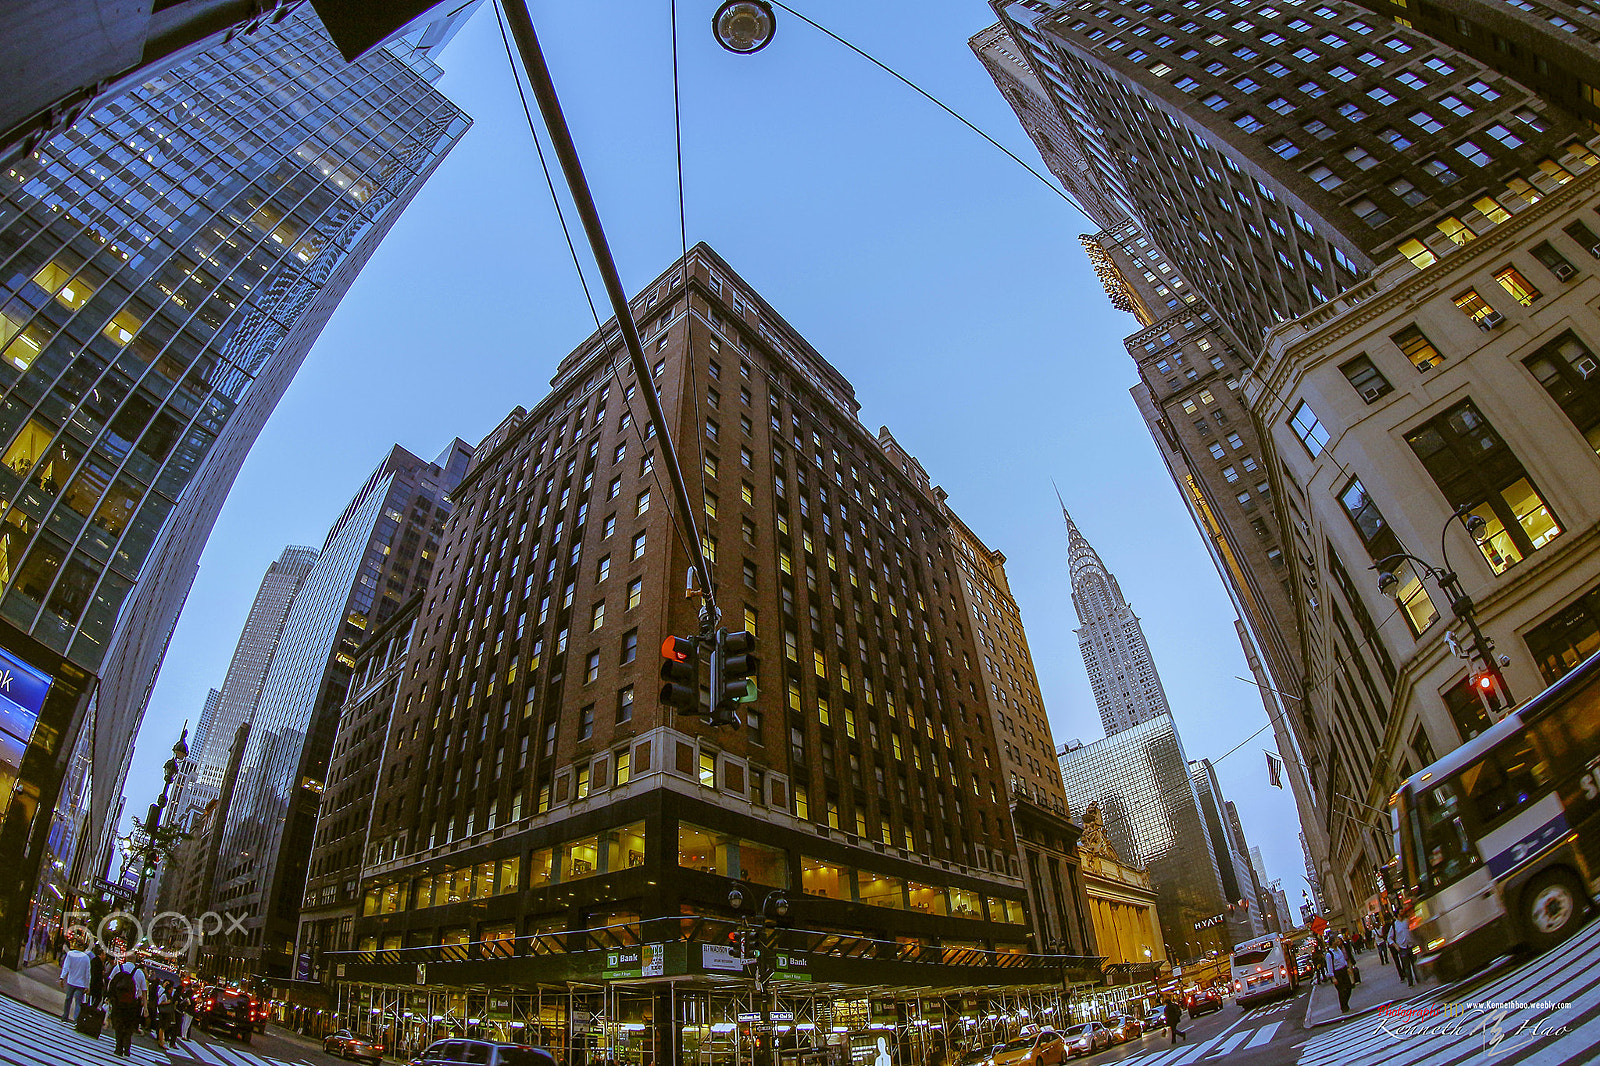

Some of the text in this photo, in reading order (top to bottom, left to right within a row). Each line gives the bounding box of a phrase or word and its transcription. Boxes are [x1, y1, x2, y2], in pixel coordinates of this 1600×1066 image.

[95, 880, 131, 899] East 42nd St
[1194, 913, 1224, 930] HYATT
[608, 953, 638, 966] TD Bank
[778, 956, 807, 967] TD Bank
